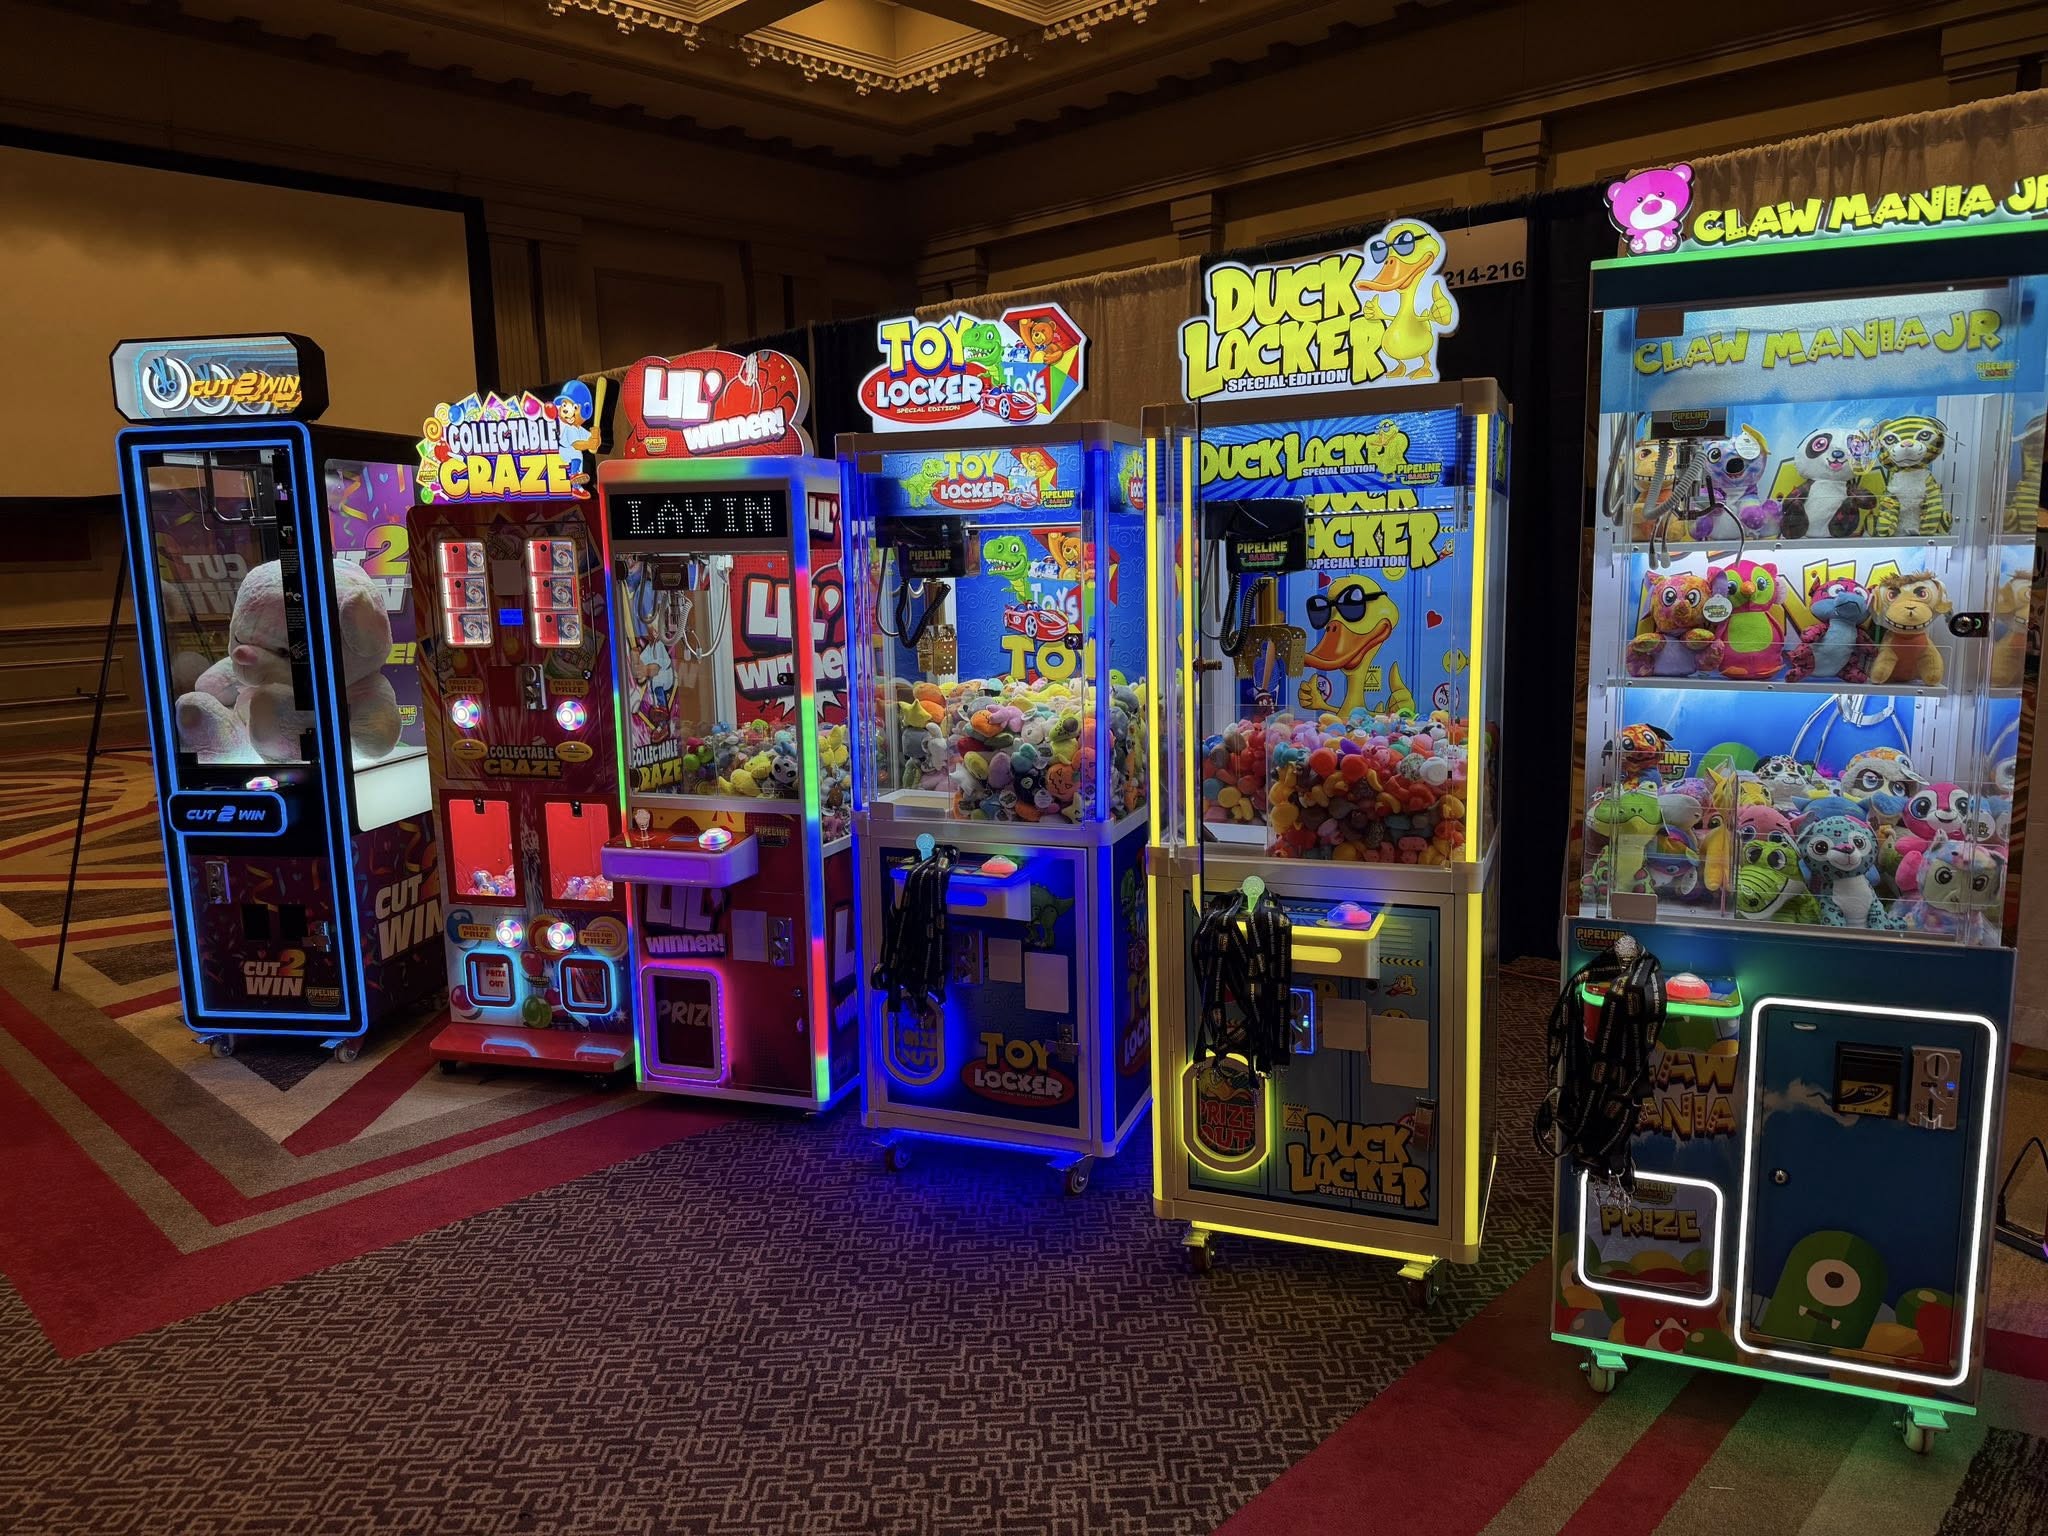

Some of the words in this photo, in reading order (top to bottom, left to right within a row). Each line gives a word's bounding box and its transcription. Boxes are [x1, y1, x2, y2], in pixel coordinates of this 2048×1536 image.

[1694, 198, 1822, 244] CLAW
[1828, 184, 1997, 232] MANIA
[1443, 261, 1525, 287] 214-216
[1212, 254, 1366, 335] DUCK
[881, 316, 980, 377] TOY
[1634, 328, 1750, 375] CLAW
[1762, 317, 1932, 369] MANIA
[1934, 308, 2002, 353] JR
[1183, 316, 1387, 401] LOCKER
[189, 378, 235, 397] CUT
[236, 372, 259, 396] 2
[259, 375, 301, 398] WIN
[876, 374, 984, 410] LOCKER
[1228, 375, 1287, 393] SPECIAL
[1288, 370, 1348, 387] EDITION
[896, 406, 926, 414] SPECIAL
[927, 404, 961, 413] EDITION
[450, 419, 559, 454] COLLECTABLE
[944, 449, 1001, 481] TOY
[1201, 435, 1286, 486] DUCK
[1302, 466, 1339, 477] SPECIAL
[1339, 464, 1376, 475] EDITION
[1397, 462, 1443, 474] PIPELINE
[440, 454, 572, 497] CRAZE
[940, 481, 1006, 500] LOCKER
[722, 497, 773, 533] IN
[909, 549, 952, 560] PIPELINE
[1236, 540, 1288, 554] PIPELINE
[1357, 556, 1408, 568] EDITION
[1030, 582, 1080, 625] TOYS
[554, 686, 584, 694] PRIZE
[489, 745, 555, 759] COLLECTABLE
[483, 760, 562, 776] CRAZE
[186, 810, 217, 821] CUT
[216, 805, 235, 822] 2
[238, 809, 266, 822] WIN
[754, 825, 791, 837] PIPELINE
[375, 873, 423, 920] CUT
[463, 930, 491, 938] PRIZE
[583, 937, 613, 945] PRIZE
[243, 961, 280, 976] CUT
[280, 948, 306, 977] 2
[486, 969, 506, 977] PRIZE
[245, 976, 304, 996] WIN
[489, 980, 505, 988] OUT
[981, 1032, 1049, 1072] TOY
[974, 1068, 1063, 1099] LOCKER
[1306, 1114, 1412, 1164] DUCK
[1287, 1143, 1428, 1209] LOCKER
[1319, 1185, 1360, 1200] SPECIAL
[1360, 1190, 1402, 1205] EDITION
[1600, 1204, 1701, 1243] PRIZE
